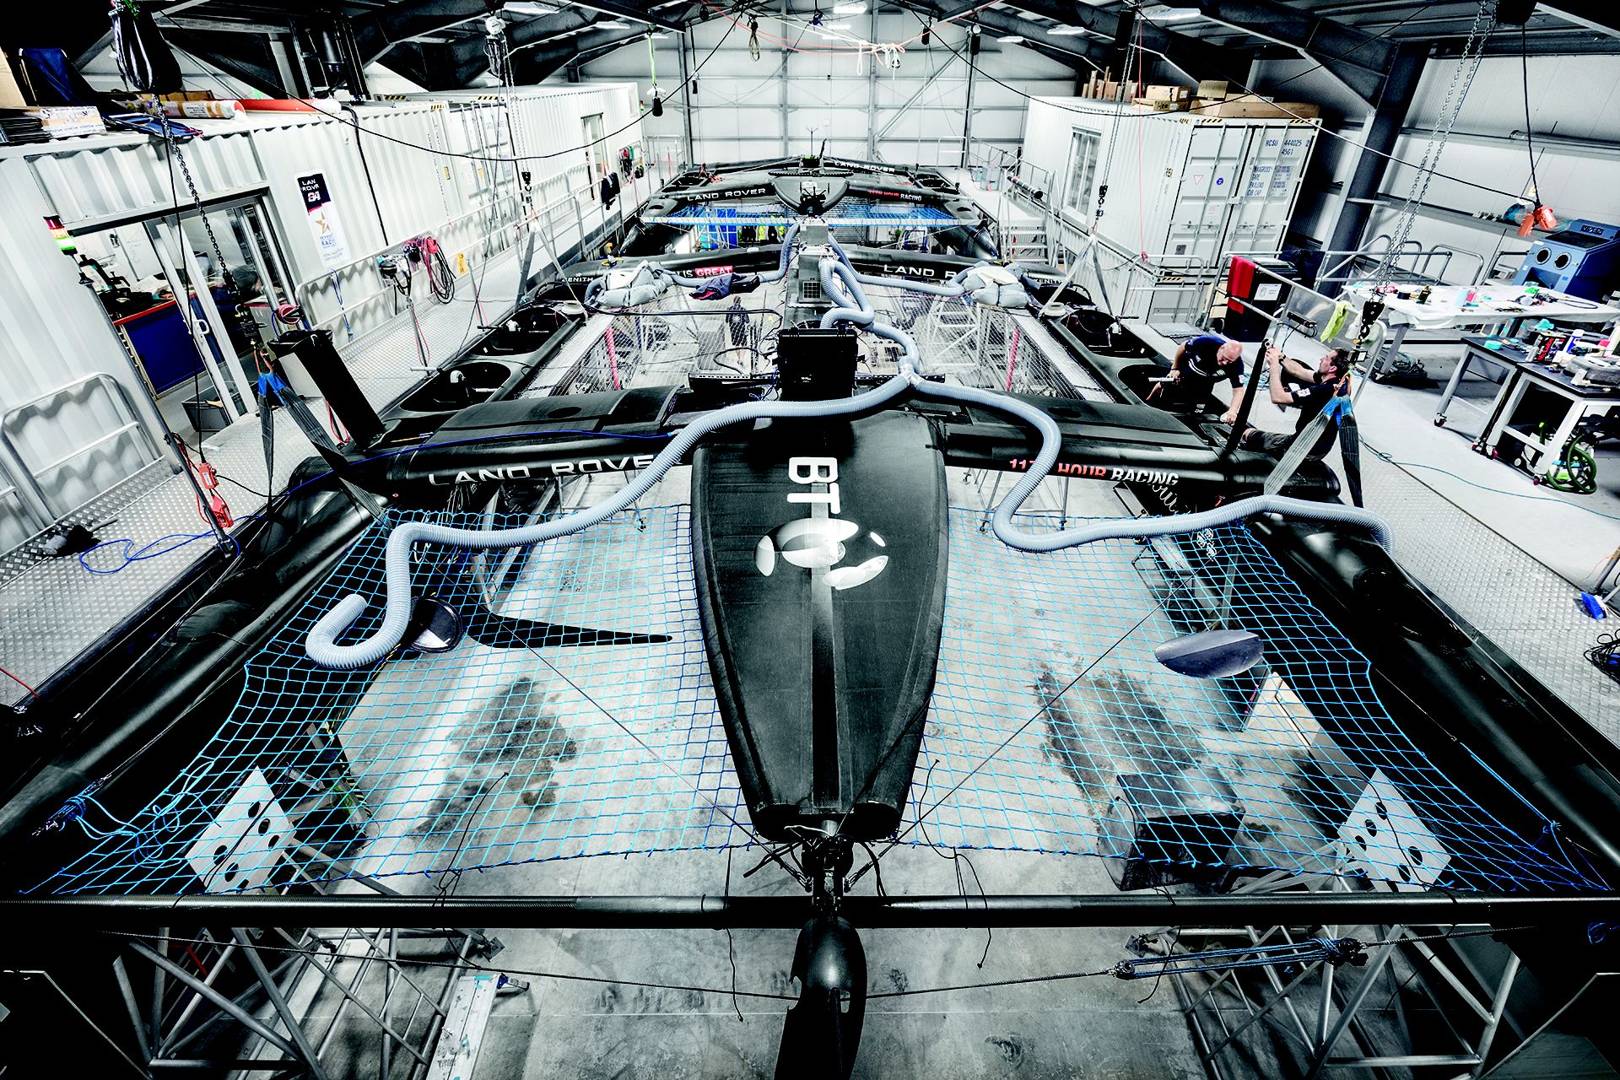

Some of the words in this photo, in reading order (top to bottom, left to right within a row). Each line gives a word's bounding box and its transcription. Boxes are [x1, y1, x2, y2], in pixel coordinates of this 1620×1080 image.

[687, 192, 719, 202] LAND
[724, 187, 766, 198] ROVER
[900, 193, 922, 201] RACING
[695, 266, 732, 277] GREAT
[883, 264, 935, 277] LAND
[428, 465, 531, 486] LAND
[551, 454, 655, 476] ROVE
[1057, 462, 1107, 477] HOUR
[1110, 467, 1180, 486] RACING
[786, 456, 841, 514] BT
